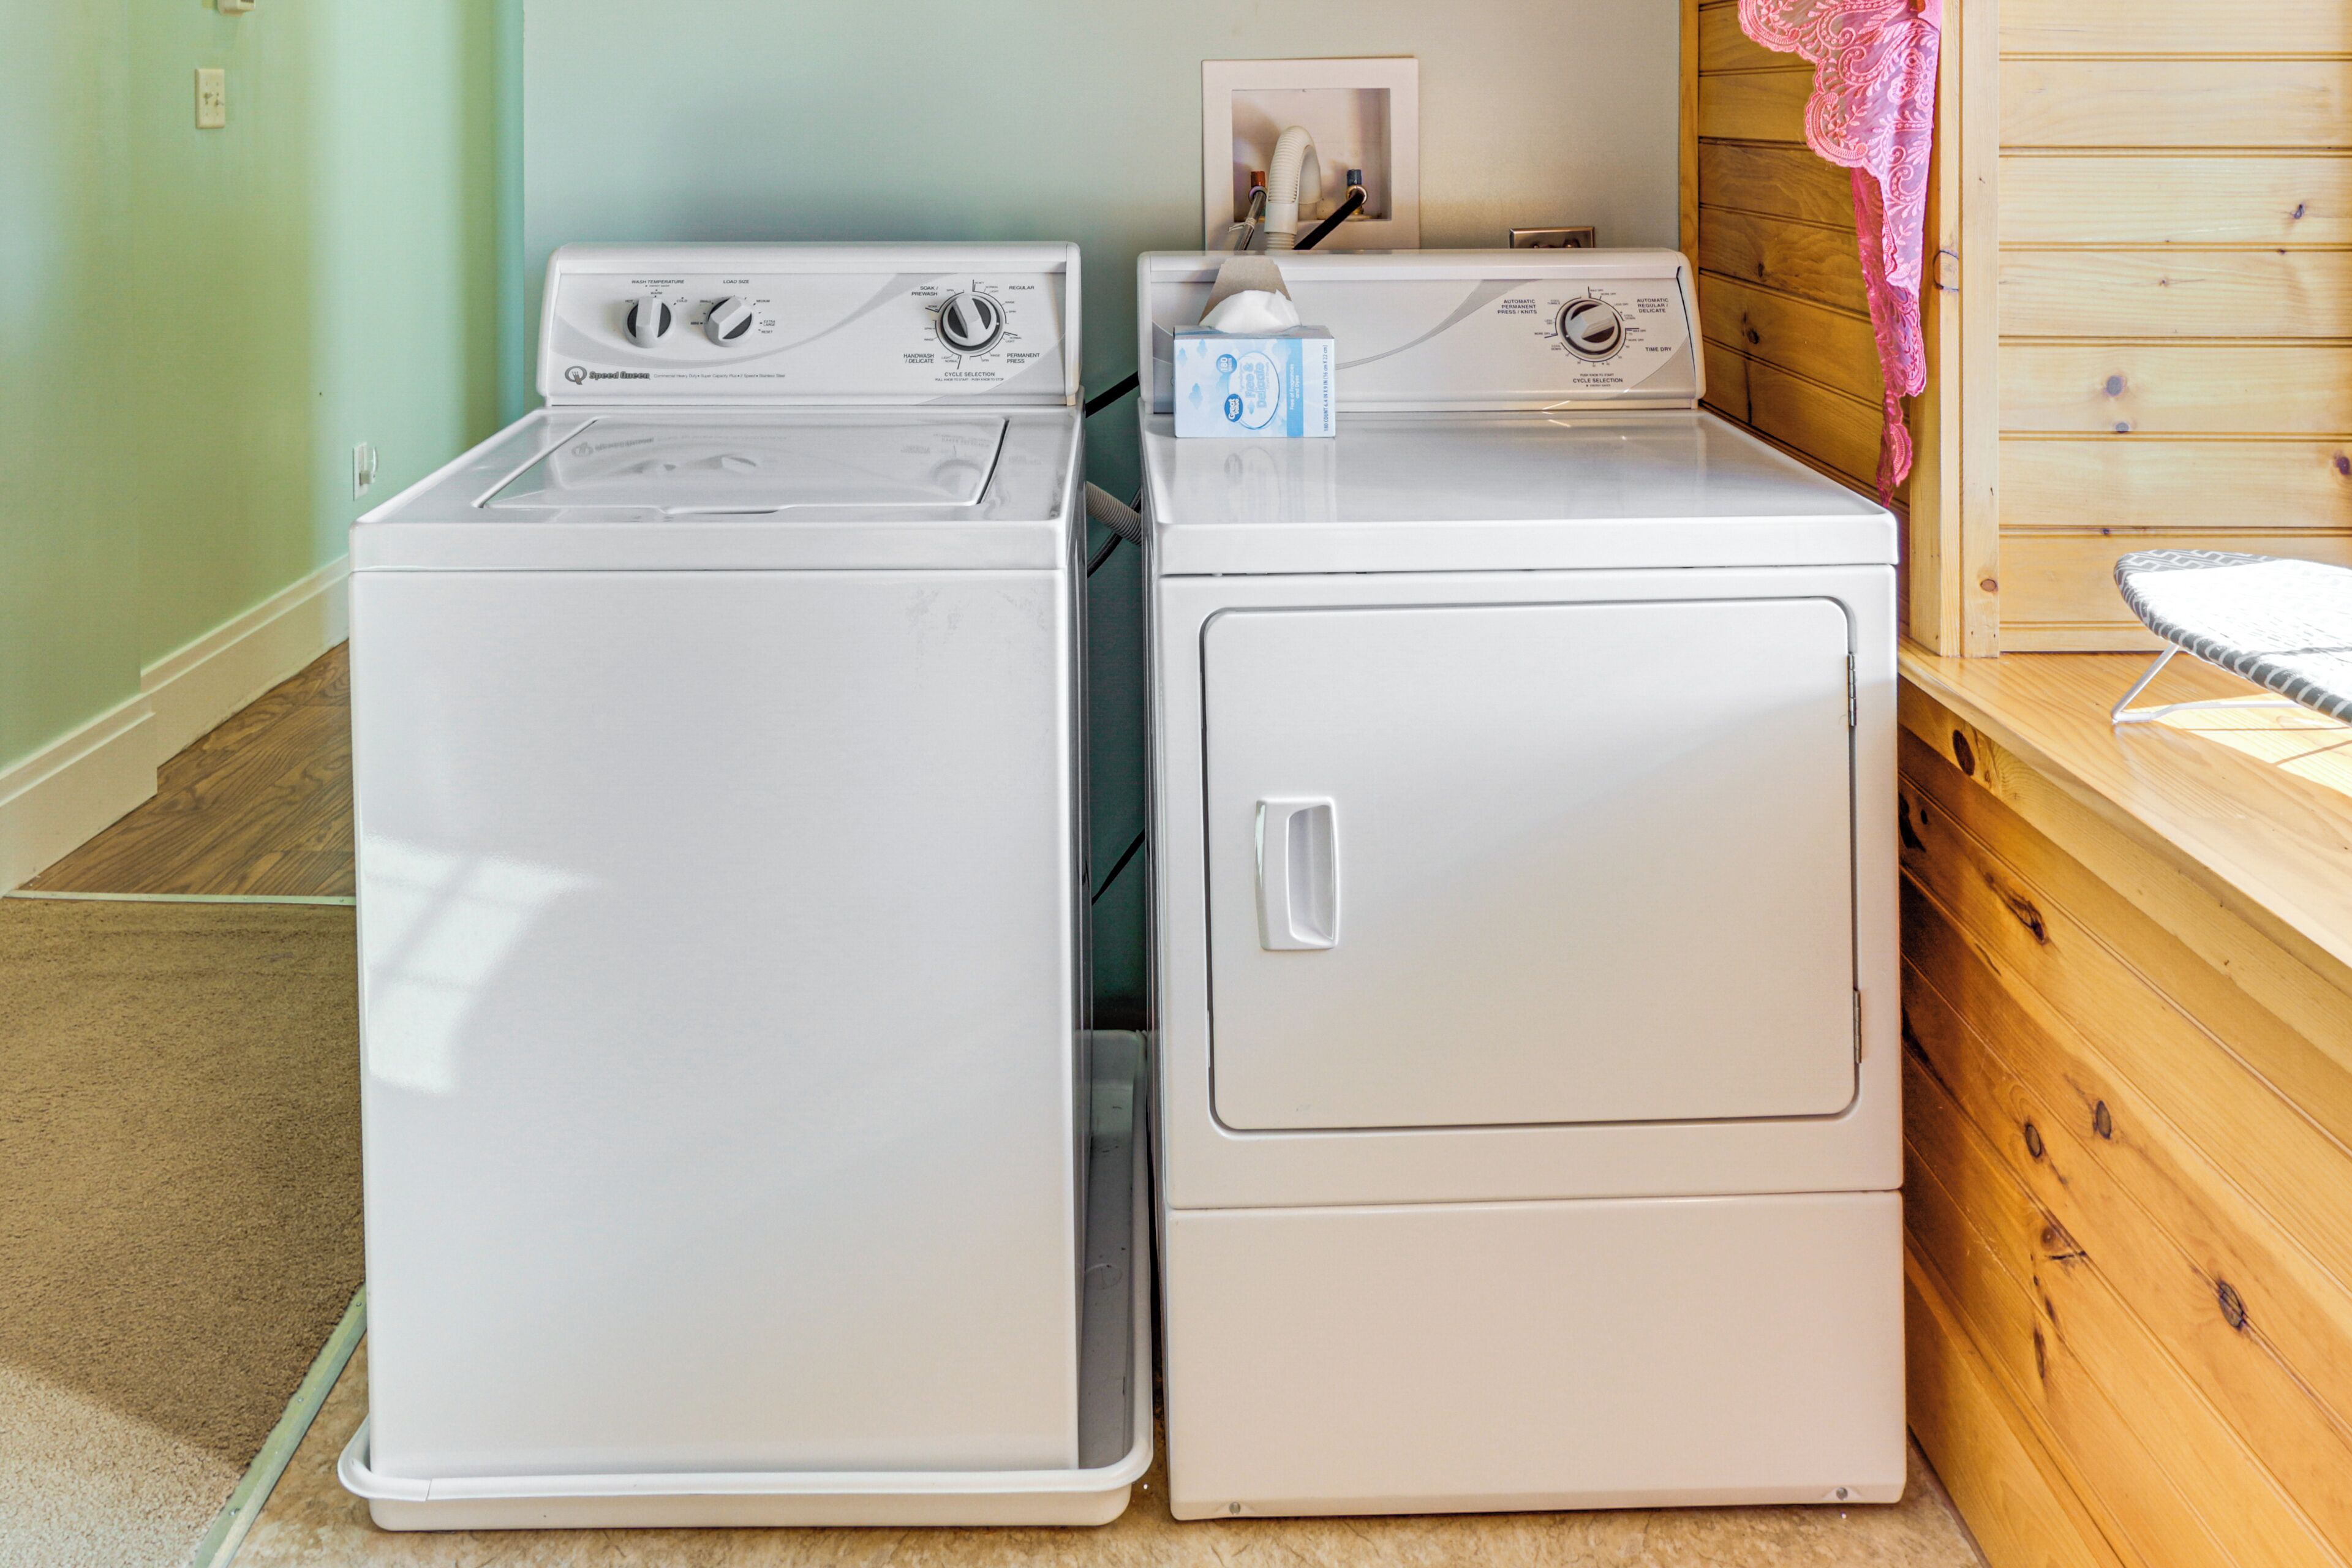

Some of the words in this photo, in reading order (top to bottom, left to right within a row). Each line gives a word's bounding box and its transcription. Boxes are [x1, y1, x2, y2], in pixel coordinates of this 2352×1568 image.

[589, 371, 619, 380] Speed
[1244, 363, 1254, 373] &
[1245, 373, 1255, 398] Free
[1255, 362, 1267, 408] Delicate
